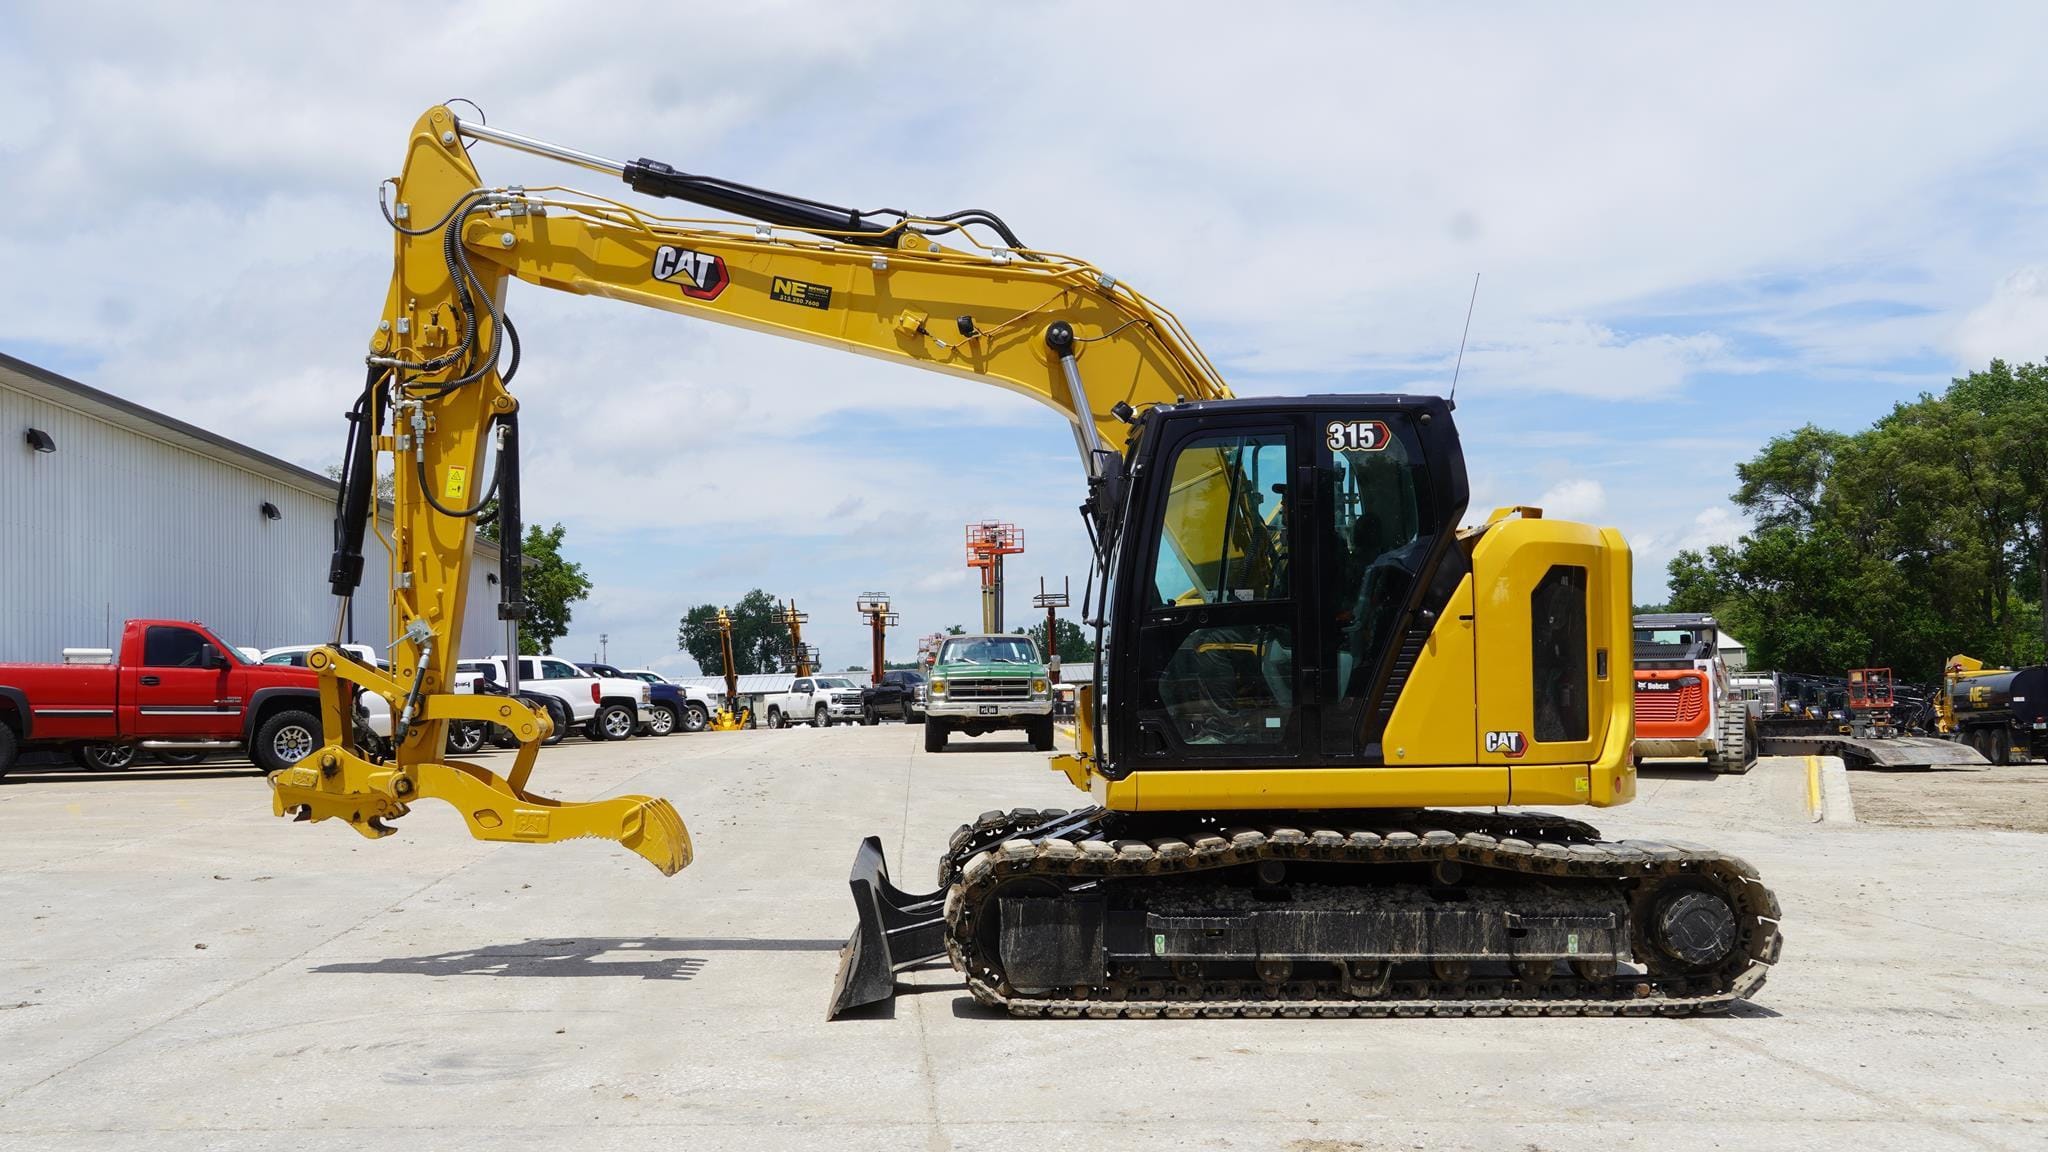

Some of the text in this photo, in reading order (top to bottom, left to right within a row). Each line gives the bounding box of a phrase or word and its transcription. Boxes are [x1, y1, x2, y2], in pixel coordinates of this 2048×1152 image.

[655, 246, 714, 288] CAT
[773, 278, 807, 298] NE
[1329, 423, 1375, 449] 315
[1647, 682, 1670, 690] Bobcat
[1486, 731, 1519, 752] CAT
